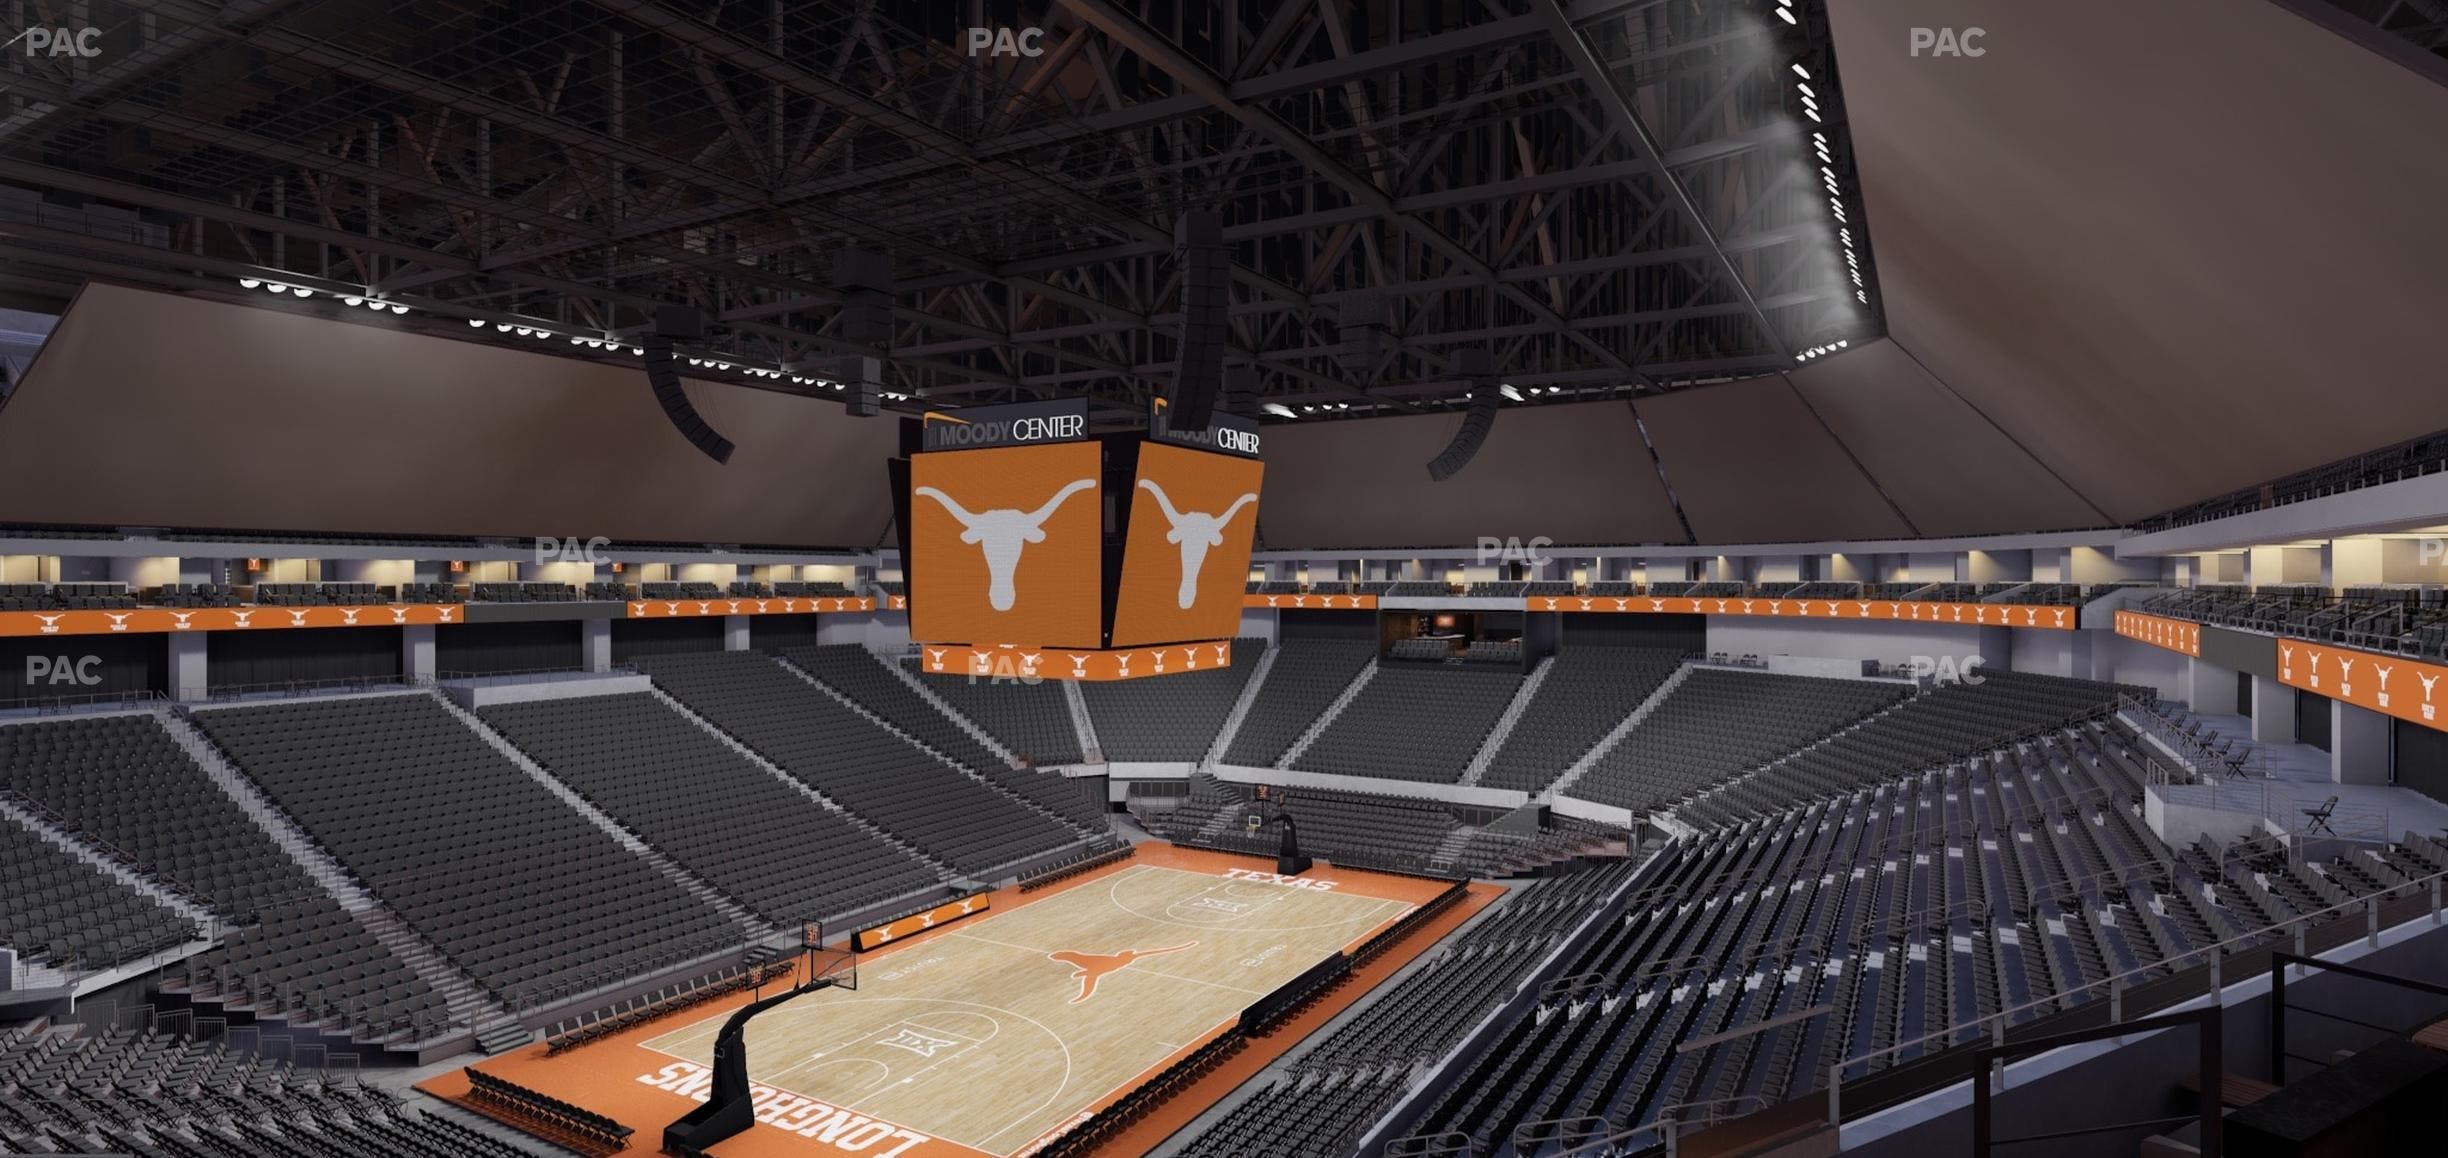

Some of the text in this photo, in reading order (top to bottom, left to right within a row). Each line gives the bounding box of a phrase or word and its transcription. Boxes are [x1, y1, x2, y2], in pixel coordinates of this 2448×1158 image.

[940, 414, 1084, 446] MOODY CENTER
[1217, 427, 1260, 454] CENTER
[1221, 868, 1340, 891] TEXAS
